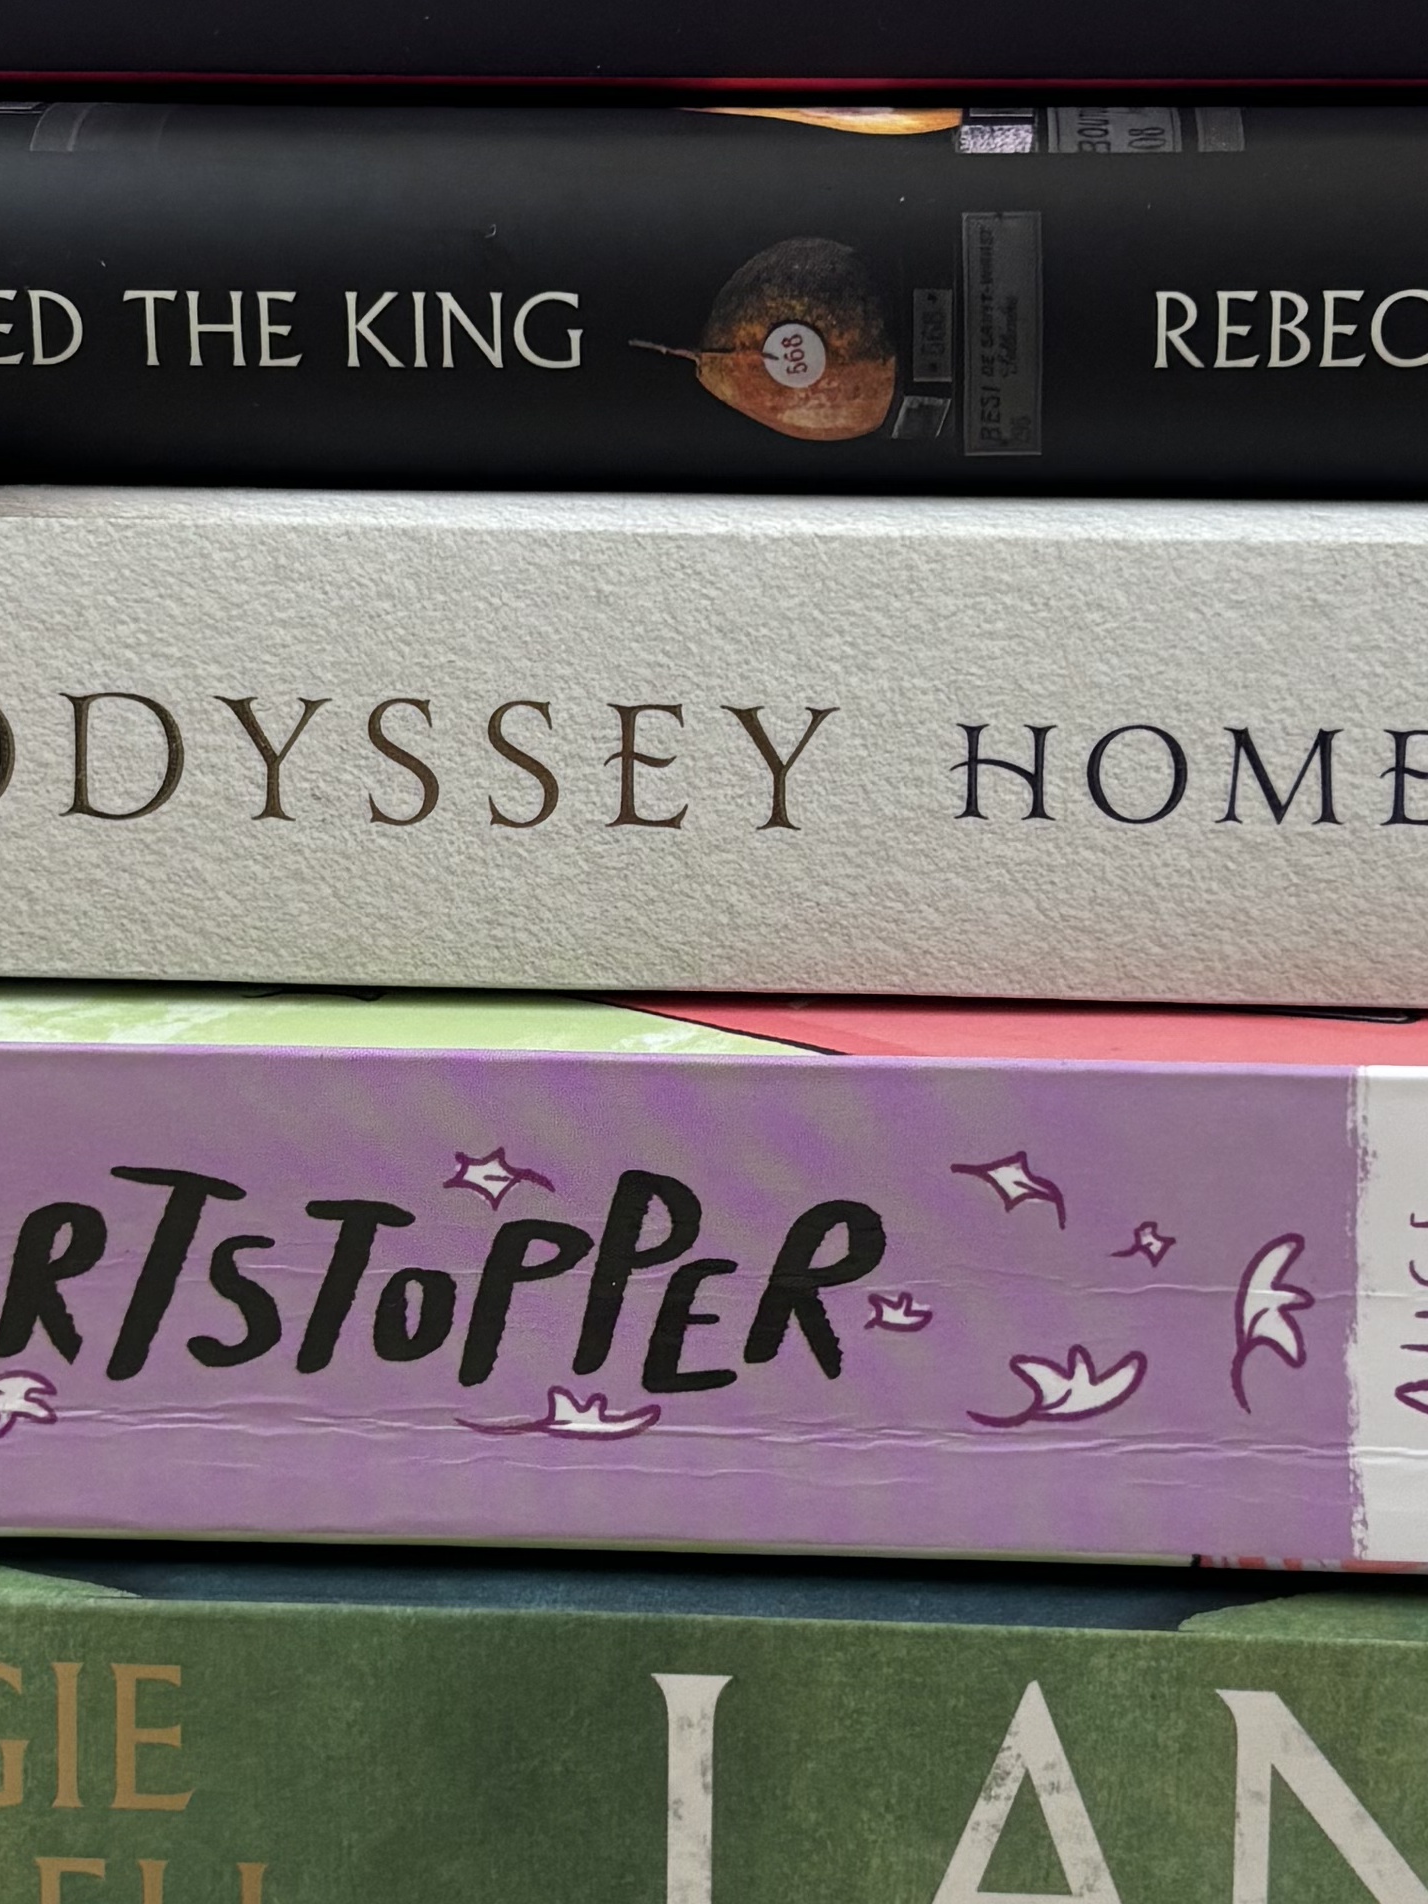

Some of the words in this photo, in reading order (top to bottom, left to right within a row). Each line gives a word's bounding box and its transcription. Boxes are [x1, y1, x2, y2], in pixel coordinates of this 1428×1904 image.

[122, 289, 302, 368] THE
[344, 290, 583, 369] KING
[780, 333, 808, 375] 568
